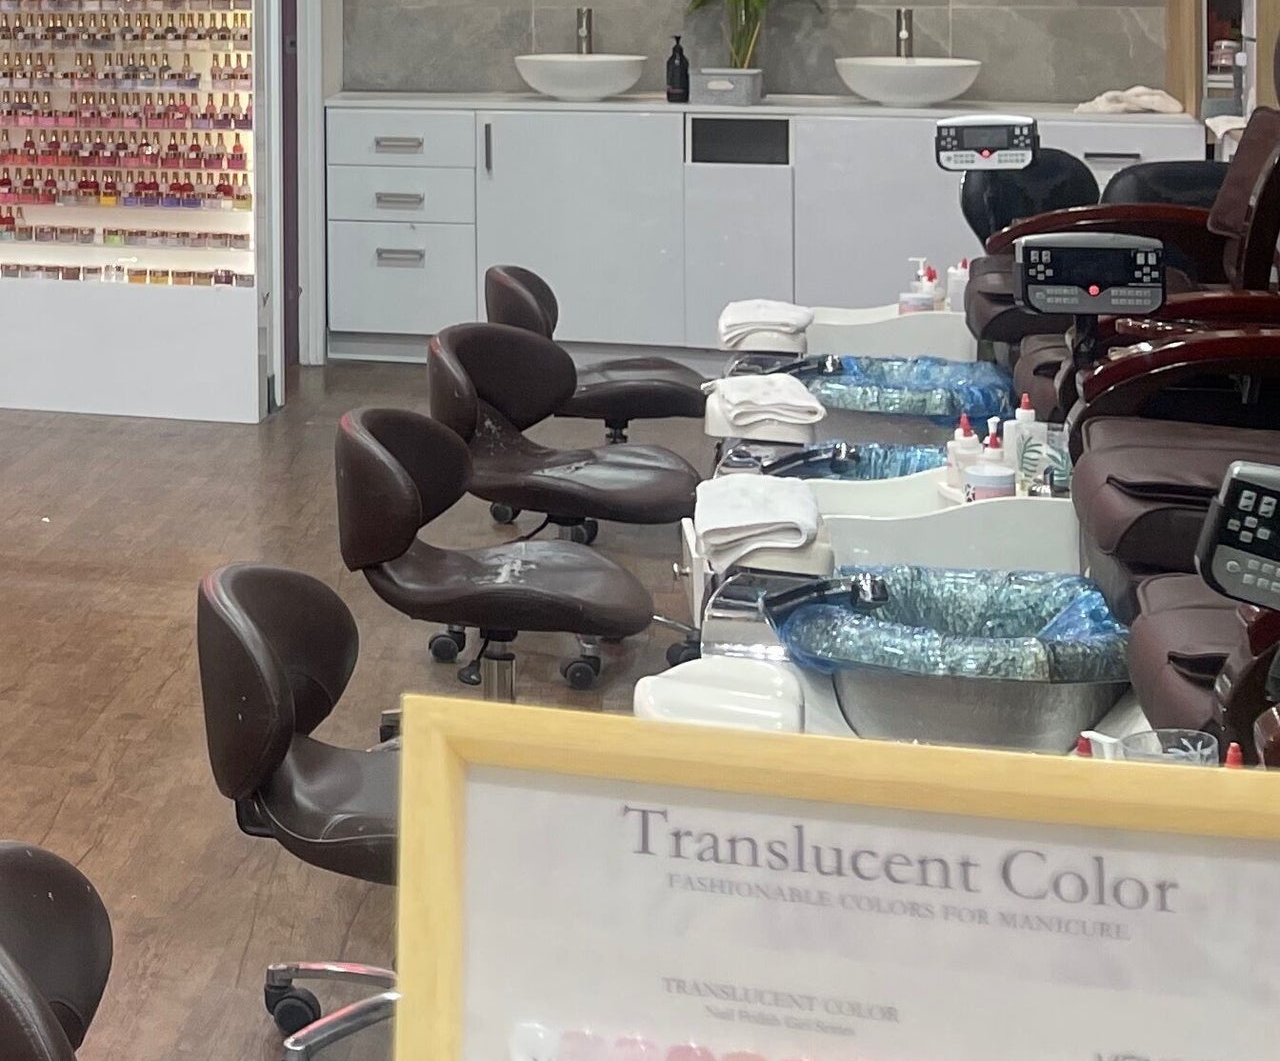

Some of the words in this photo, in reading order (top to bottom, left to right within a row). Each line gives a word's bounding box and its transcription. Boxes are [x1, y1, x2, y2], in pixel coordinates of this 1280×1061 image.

[623, 804, 982, 894] Translucent
[1001, 848, 1180, 913] Color
[667, 873, 832, 908] FASHIONABLE
[840, 892, 937, 921] COLORS
[940, 902, 991, 926] FOR
[999, 911, 1131, 940] MANICURE
[661, 976, 818, 1012] TRANSLUCENT
[824, 998, 900, 1023] COLOR
